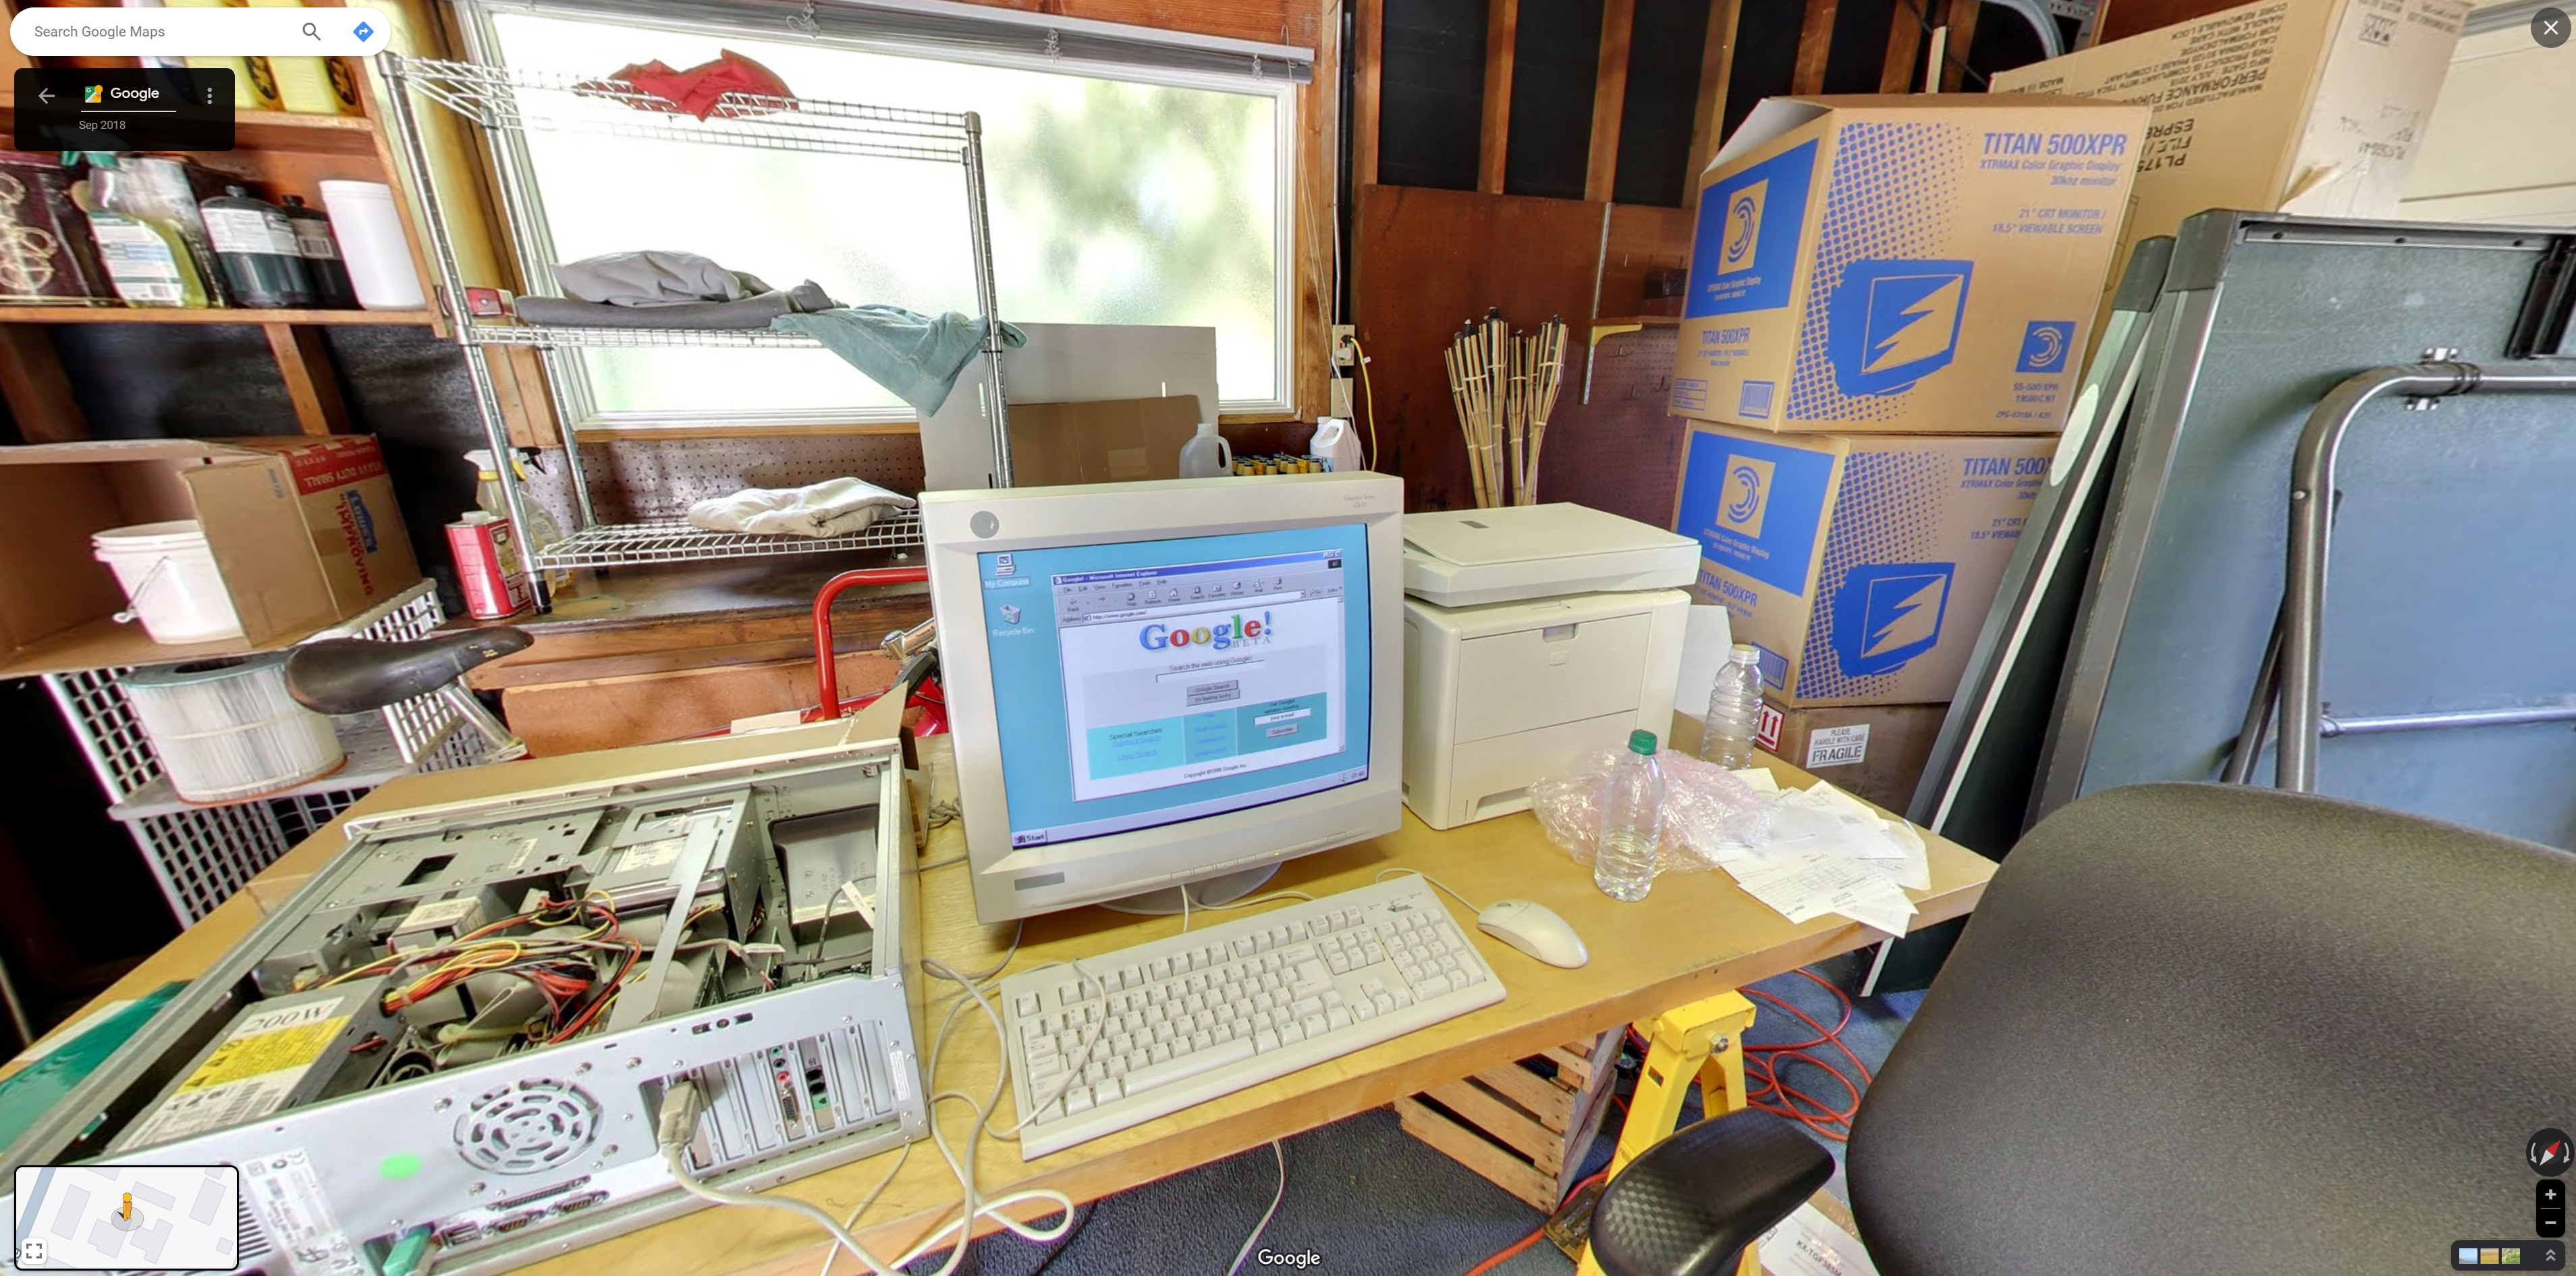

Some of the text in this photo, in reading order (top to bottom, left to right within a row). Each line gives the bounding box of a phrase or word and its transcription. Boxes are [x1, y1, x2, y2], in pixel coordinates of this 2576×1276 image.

[2259, 24, 2281, 36] FOR
[2219, 35, 2278, 56] CALIFORNIA
[2252, 46, 2274, 58] THIS
[2204, 52, 2250, 69] PRODUCT
[2104, 67, 2152, 84] COMPLIANT
[2141, 66, 2191, 85] COMPLIANT
[2165, 68, 2268, 101] PERFORMANCE
[2185, 84, 2263, 106] MANUFACTURED
[2165, 101, 2184, 111] FOR
[1983, 132, 2128, 156] TITAN 500XPR
[2022, 160, 2046, 169] Color
[2048, 160, 2084, 172] Graphic
[2087, 161, 2121, 173] Display
[2080, 176, 2116, 186] monitor
[2037, 209, 2055, 219] CRT
[2058, 209, 2101, 219] MONITOR
[2018, 223, 2063, 233] VIEWABLE
[2066, 224, 2103, 234] SCREEN
[1701, 327, 1751, 345] TITAN 500XPR
[1964, 456, 2012, 477] TITAN
[304, 473, 335, 489] SMALL
[1961, 480, 1993, 489] XTRMAX
[1994, 479, 2015, 488] Color
[2007, 518, 2021, 527] CRT
[335, 504, 374, 597] IMPROVING
[1751, 545, 1770, 560] Display
[1089, 573, 1114, 581] Microsoft
[1136, 570, 1158, 578] Explorer
[985, 578, 1030, 589] My Computer
[1112, 582, 1133, 590] Favorites
[1698, 568, 1722, 591] TITAN
[1722, 580, 1759, 608] 500XPR
[1092, 610, 1147, 620] http://www.google.com/
[992, 626, 1035, 637] Recycle Bin
[1139, 610, 1272, 651] Google!
[1232, 637, 1271, 649] BETA
[1169, 655, 1253, 673] Search the web using Google!
[1195, 685, 1213, 694] Google
[1202, 694, 1218, 703] feeling
[1218, 693, 1232, 701] lucky
[1263, 703, 1300, 715] updates monthly
[1109, 727, 1163, 741] Special Searches
[1271, 726, 1294, 735] Subscribe
[1830, 728, 1851, 737] PLEASE
[1813, 737, 1836, 746] HANDLE
[1851, 733, 1866, 742] CARE
[1811, 745, 1863, 763] FRAGILE
[1184, 770, 1206, 779] Copyright
[1222, 764, 1239, 773] Google
[1026, 834, 1045, 842] Start
[242, 1002, 333, 1034] 200W
